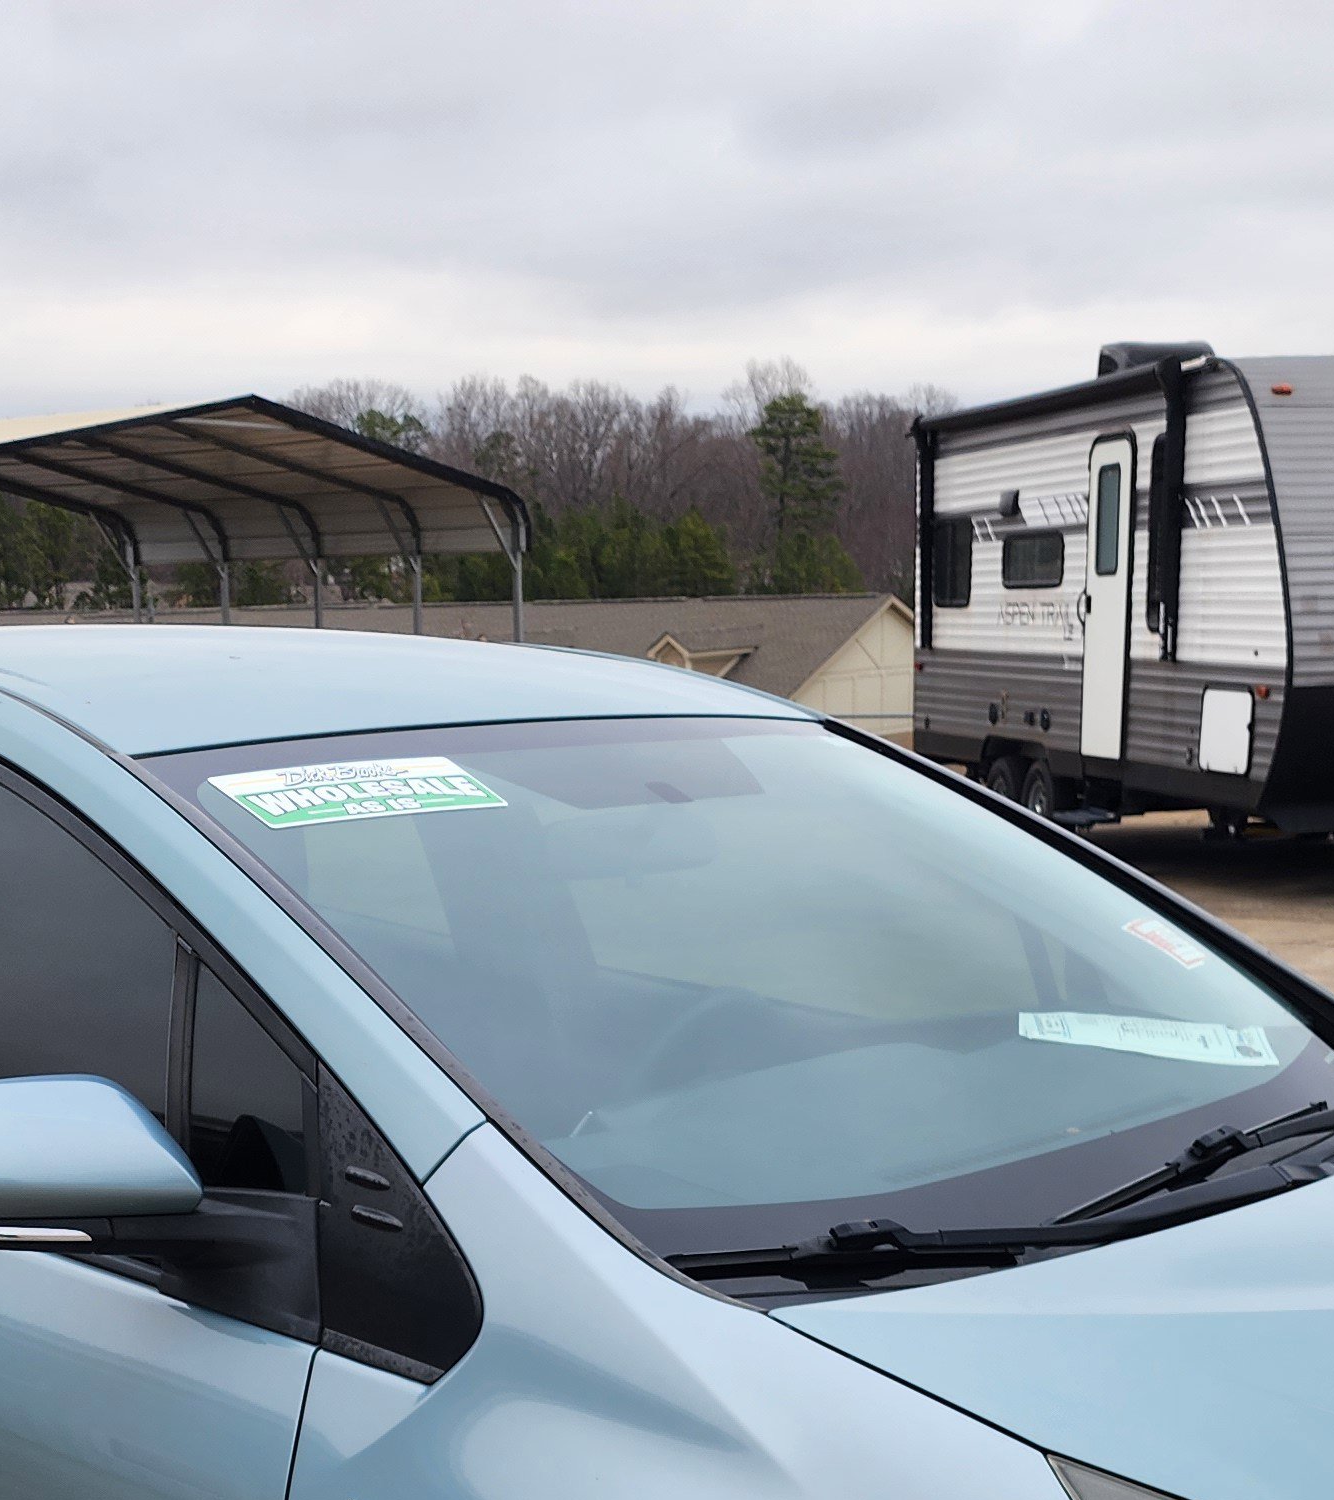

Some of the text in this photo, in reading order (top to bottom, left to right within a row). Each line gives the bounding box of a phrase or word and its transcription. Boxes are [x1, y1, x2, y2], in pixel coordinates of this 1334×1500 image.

[996, 601, 1035, 626] ASPEN
[277, 768, 333, 787] Dick
[246, 776, 487, 816] WHOLESALE
[345, 797, 424, 816] AS IS
